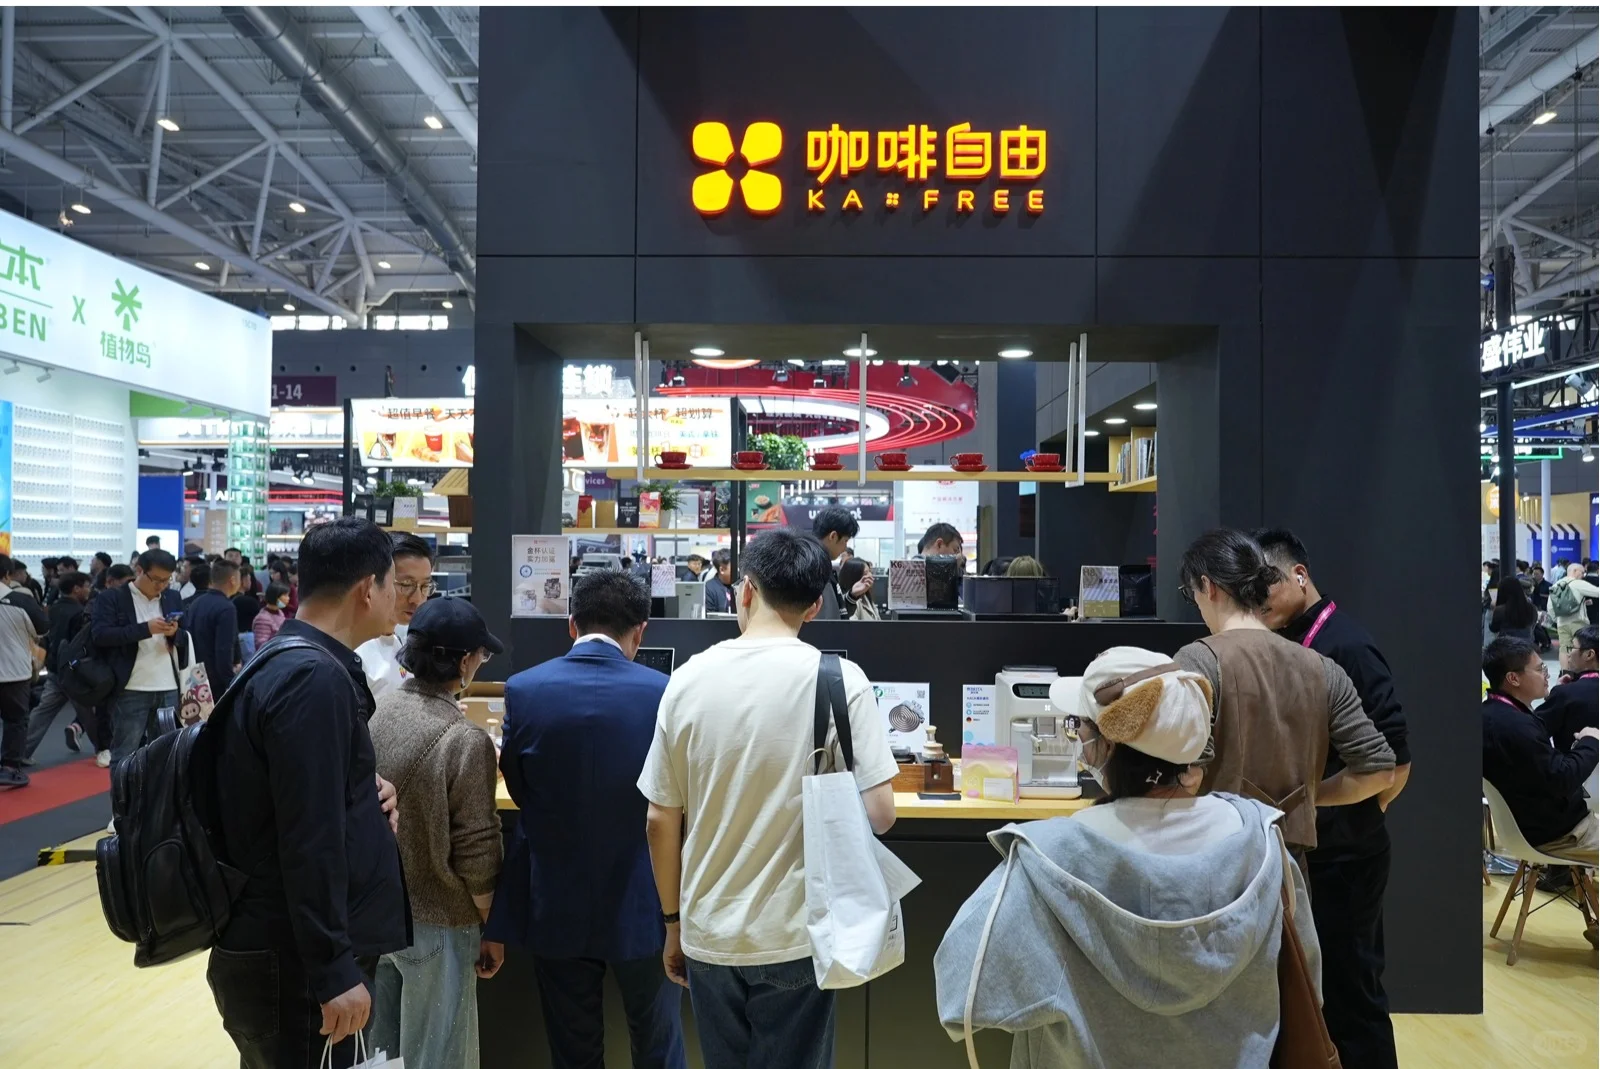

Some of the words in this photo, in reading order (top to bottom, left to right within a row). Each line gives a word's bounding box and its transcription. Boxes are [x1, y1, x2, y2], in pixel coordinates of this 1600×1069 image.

[807, 122, 1046, 184] 咖啡自由
[808, 189, 863, 211] KA
[923, 189, 1044, 212] FREE
[100, 330, 151, 369] 植物岛
[1480, 321, 1545, 372] 盛伟业
[387, 407, 435, 420] 超值早餐
[675, 407, 713, 420] 超划算
[585, 476, 606, 485] vices
[527, 547, 555, 555] 金杯认证
